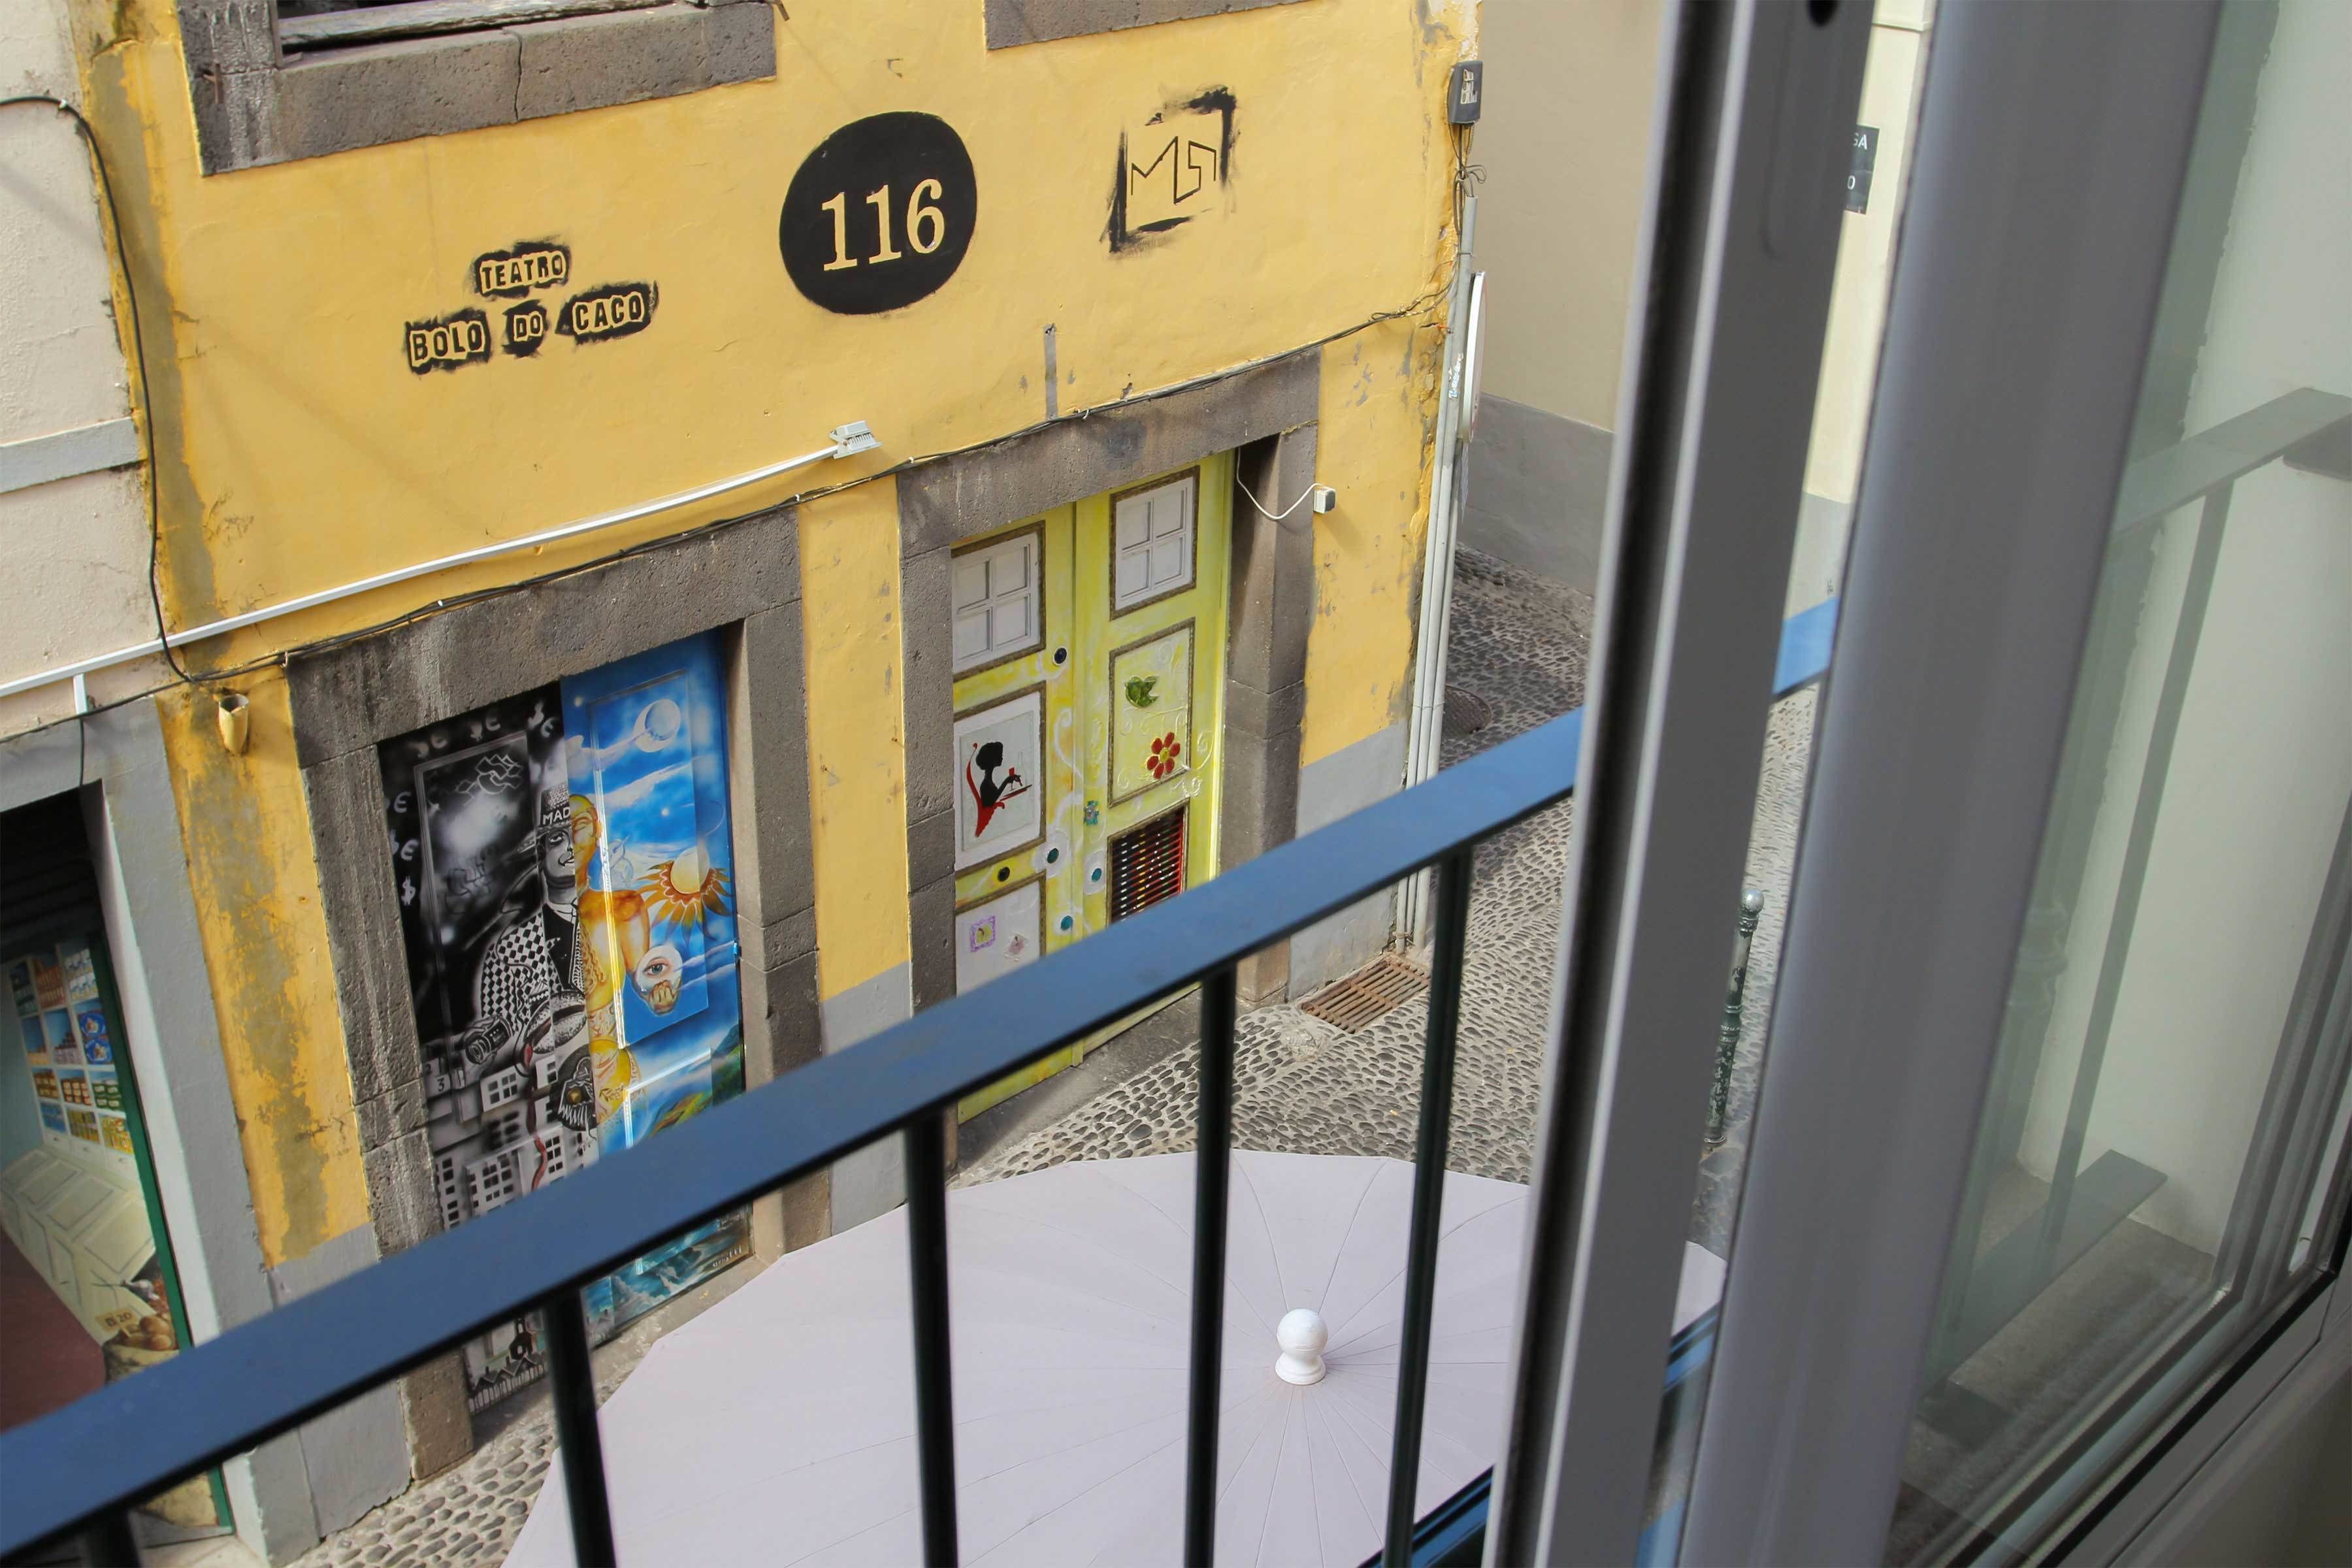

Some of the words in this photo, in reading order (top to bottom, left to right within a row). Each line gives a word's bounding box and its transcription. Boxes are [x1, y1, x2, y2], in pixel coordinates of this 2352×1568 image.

[821, 178, 945, 271] 116
[481, 253, 564, 289] TEATRO
[412, 322, 483, 361] BOLO
[515, 312, 542, 338] DO
[574, 294, 644, 331] CACO
[543, 807, 571, 825] MAD
[437, 1077, 445, 1092] 3
